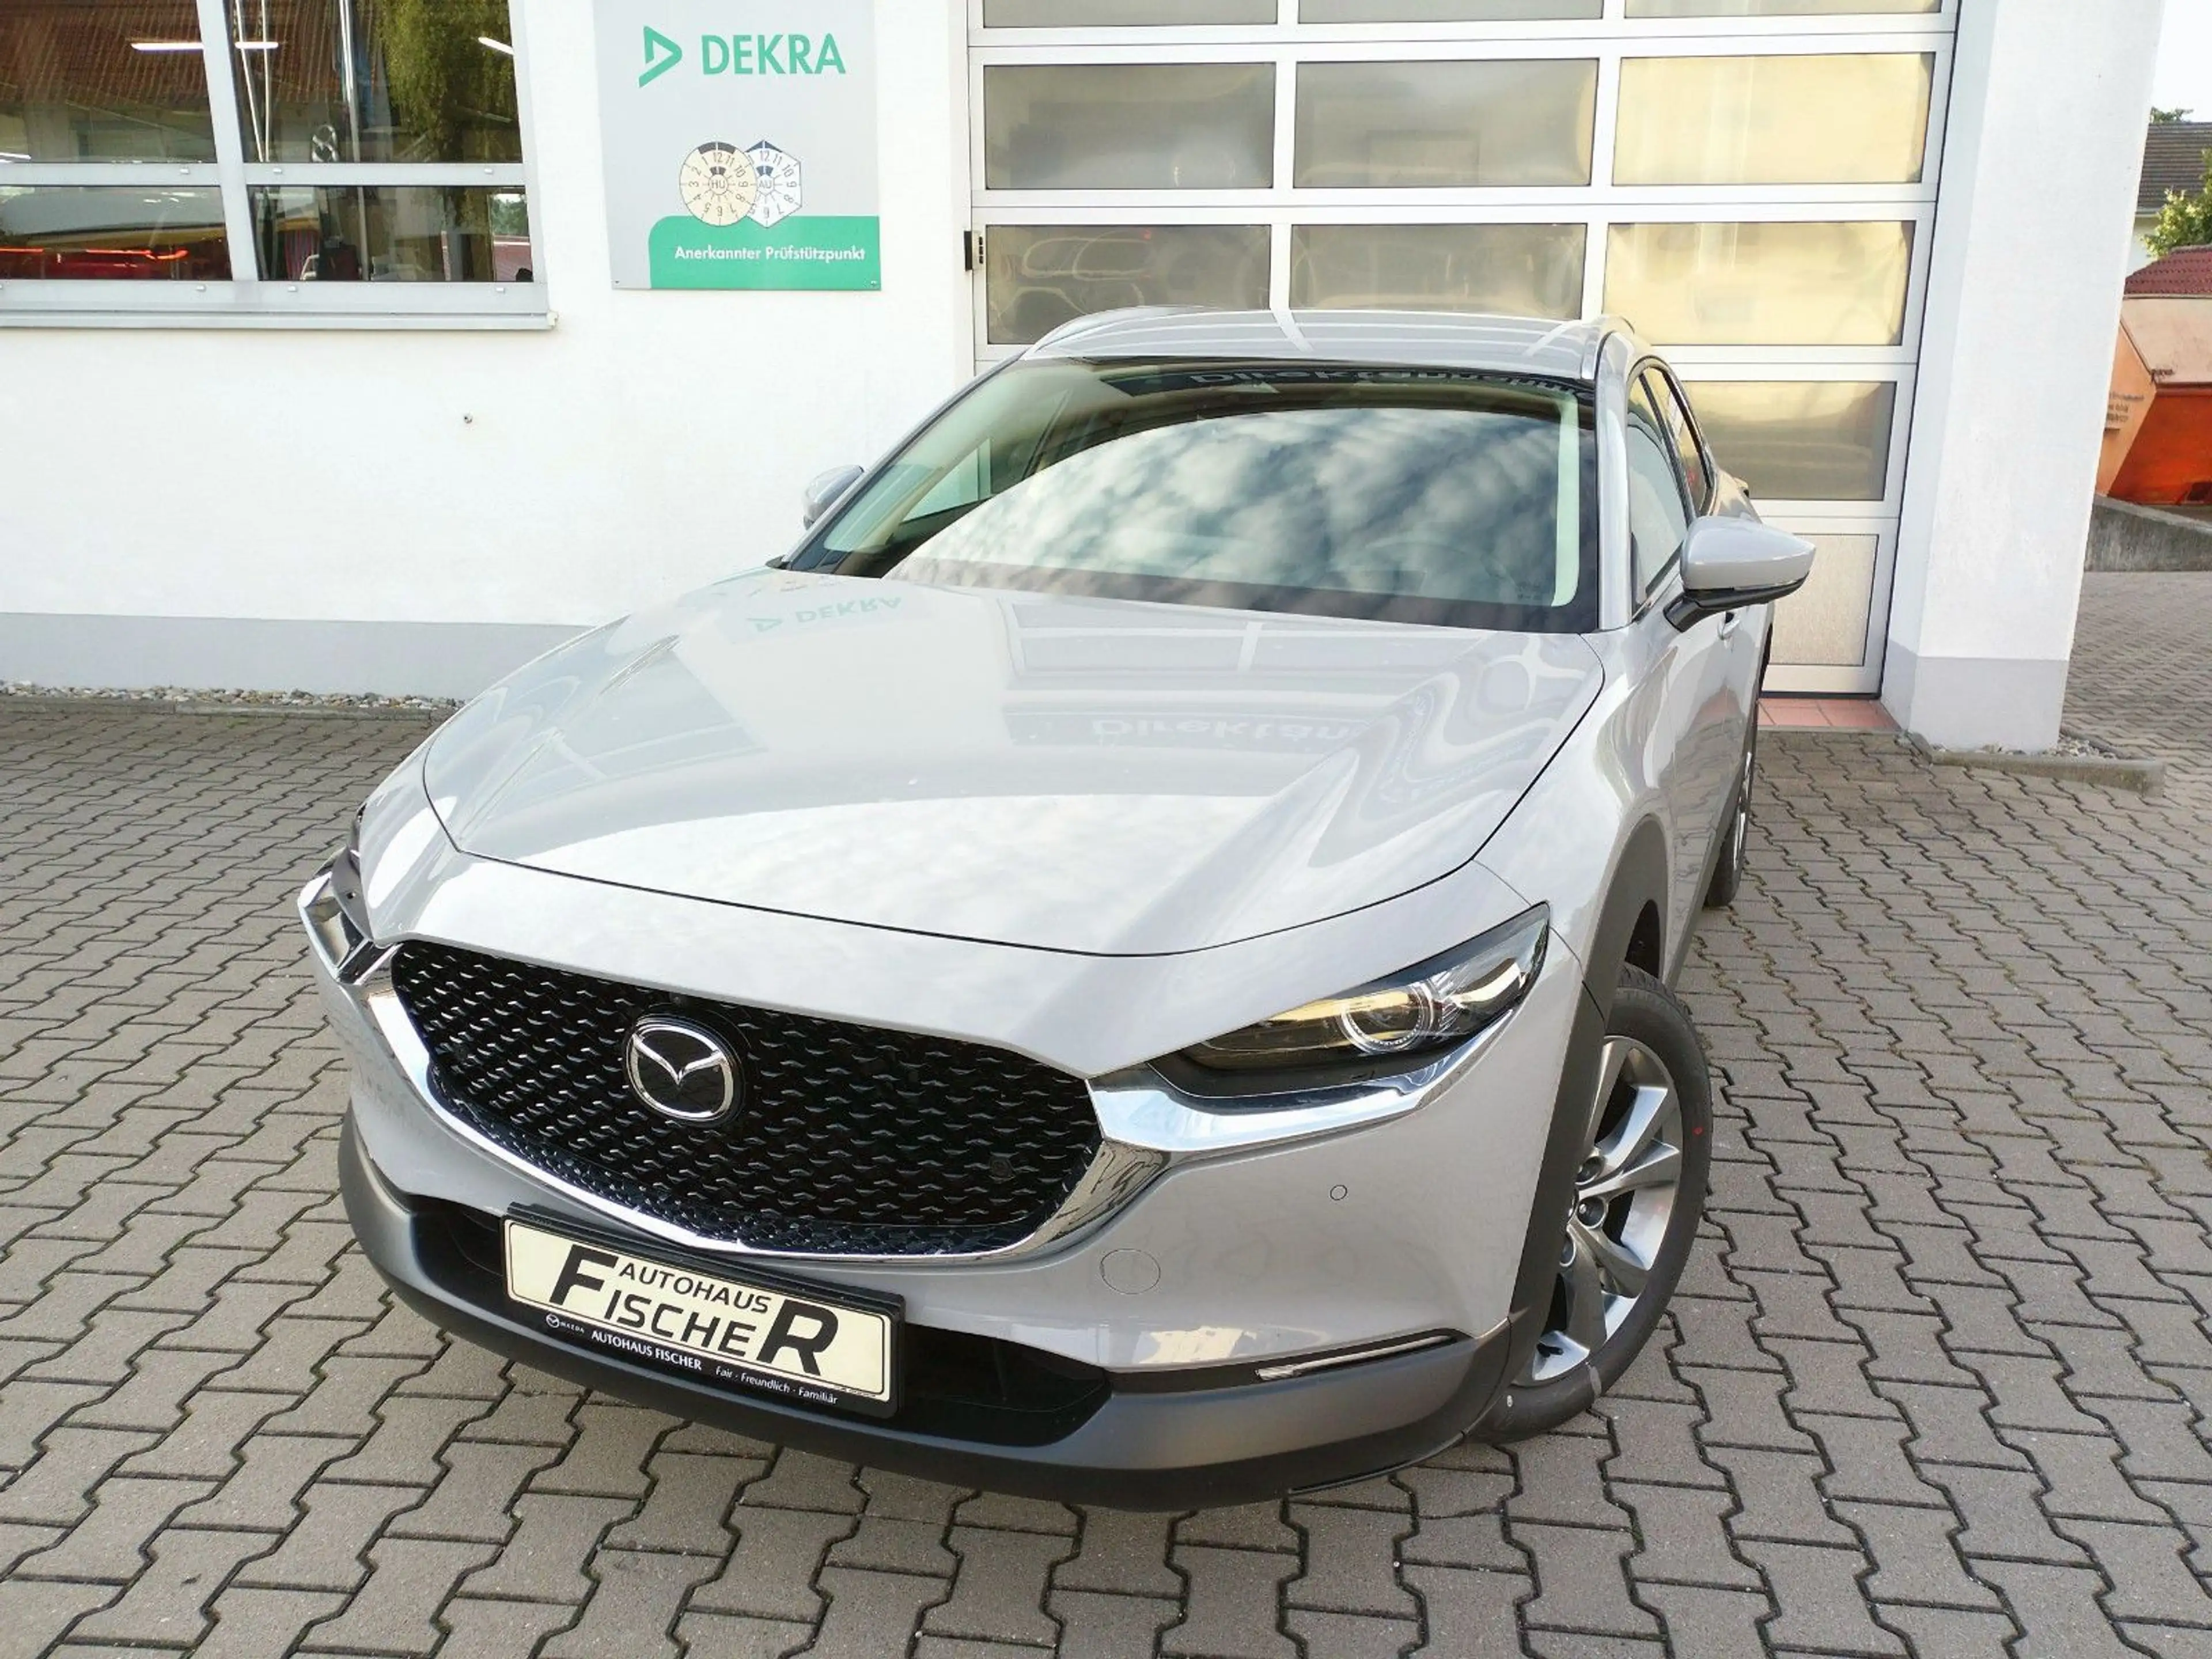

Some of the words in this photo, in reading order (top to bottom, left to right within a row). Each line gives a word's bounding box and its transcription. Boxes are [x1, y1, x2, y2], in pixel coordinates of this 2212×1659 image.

[702, 33, 846, 74] DEKRA
[713, 152, 722, 162] 12
[726, 156, 734, 166] 11
[760, 150, 770, 162] 12
[773, 154, 782, 166] 11
[782, 164, 794, 178] 10
[692, 167, 702, 176] 2
[734, 164, 746, 178] 10
[711, 180, 726, 188] HU
[759, 180, 772, 189] AU
[675, 245, 762, 260] Anerkannter
[766, 244, 866, 263] Prüfstützpunkt
[619, 1263, 771, 1313] AUTOHAUS
[559, 1321, 585, 1334] MAZDA
[591, 1330, 652, 1357] AUTOHAUS
[655, 1349, 702, 1371] FISCHER
[715, 1366, 733, 1379] Fair
[741, 1372, 790, 1393] Freundlich
[798, 1387, 839, 1404] Familiär
